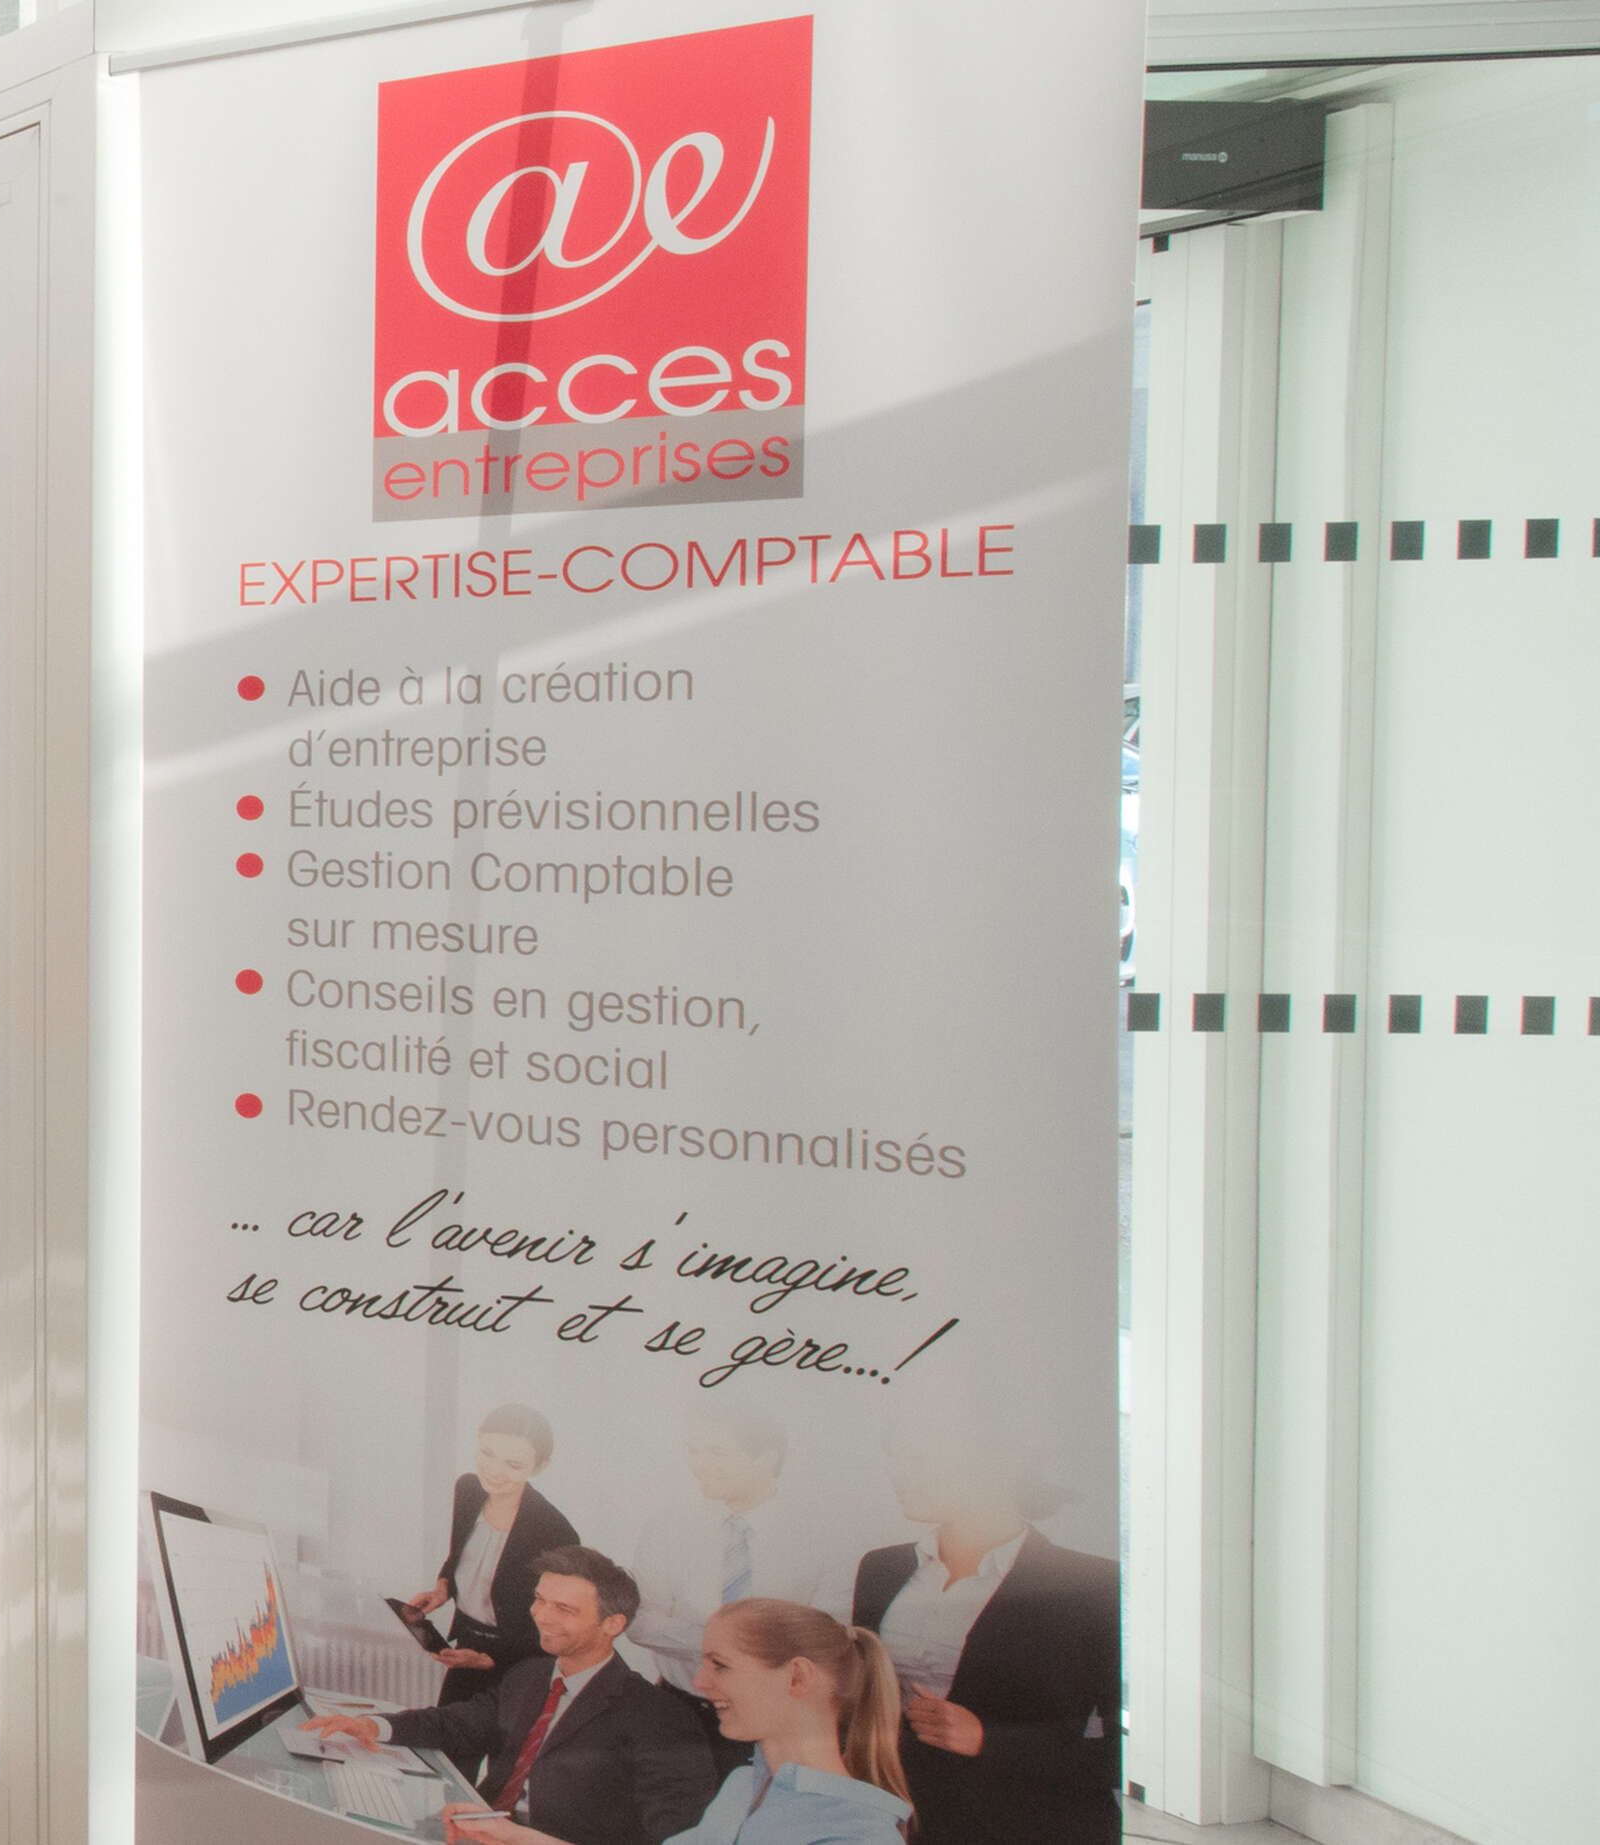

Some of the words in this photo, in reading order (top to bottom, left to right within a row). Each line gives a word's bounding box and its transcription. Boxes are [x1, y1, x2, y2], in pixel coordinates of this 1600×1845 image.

[382, 338, 793, 438] acces
[383, 431, 791, 502] entreprises
[238, 524, 1016, 607] EXPERTISE-COMPTABLE
[287, 668, 382, 707] Aide
[399, 665, 424, 705] à
[445, 666, 483, 705] la
[502, 662, 695, 704] création
[288, 729, 548, 777] d'entreprise
[288, 781, 434, 829] Études
[453, 790, 821, 840] prévisionnelles
[287, 849, 452, 892] Gestion
[470, 852, 735, 905] Comptable
[287, 916, 355, 949] sur
[372, 919, 540, 956] mesure
[286, 969, 475, 1016] Conseils
[492, 985, 547, 1020] en
[567, 985, 761, 1036] gestion,
[285, 1028, 453, 1077] fiscalité
[468, 1040, 509, 1080] et
[526, 1050, 668, 1090] social
[288, 1088, 582, 1148] Rendez-vous
[601, 1119, 968, 1180] personnalisés
[286, 1210, 364, 1241] car
[385, 1188, 597, 1265] l'avenir
[226, 1273, 279, 1305] se
[298, 1275, 555, 1333] construit
[556, 1294, 645, 1343] et
[643, 1320, 706, 1356] se
